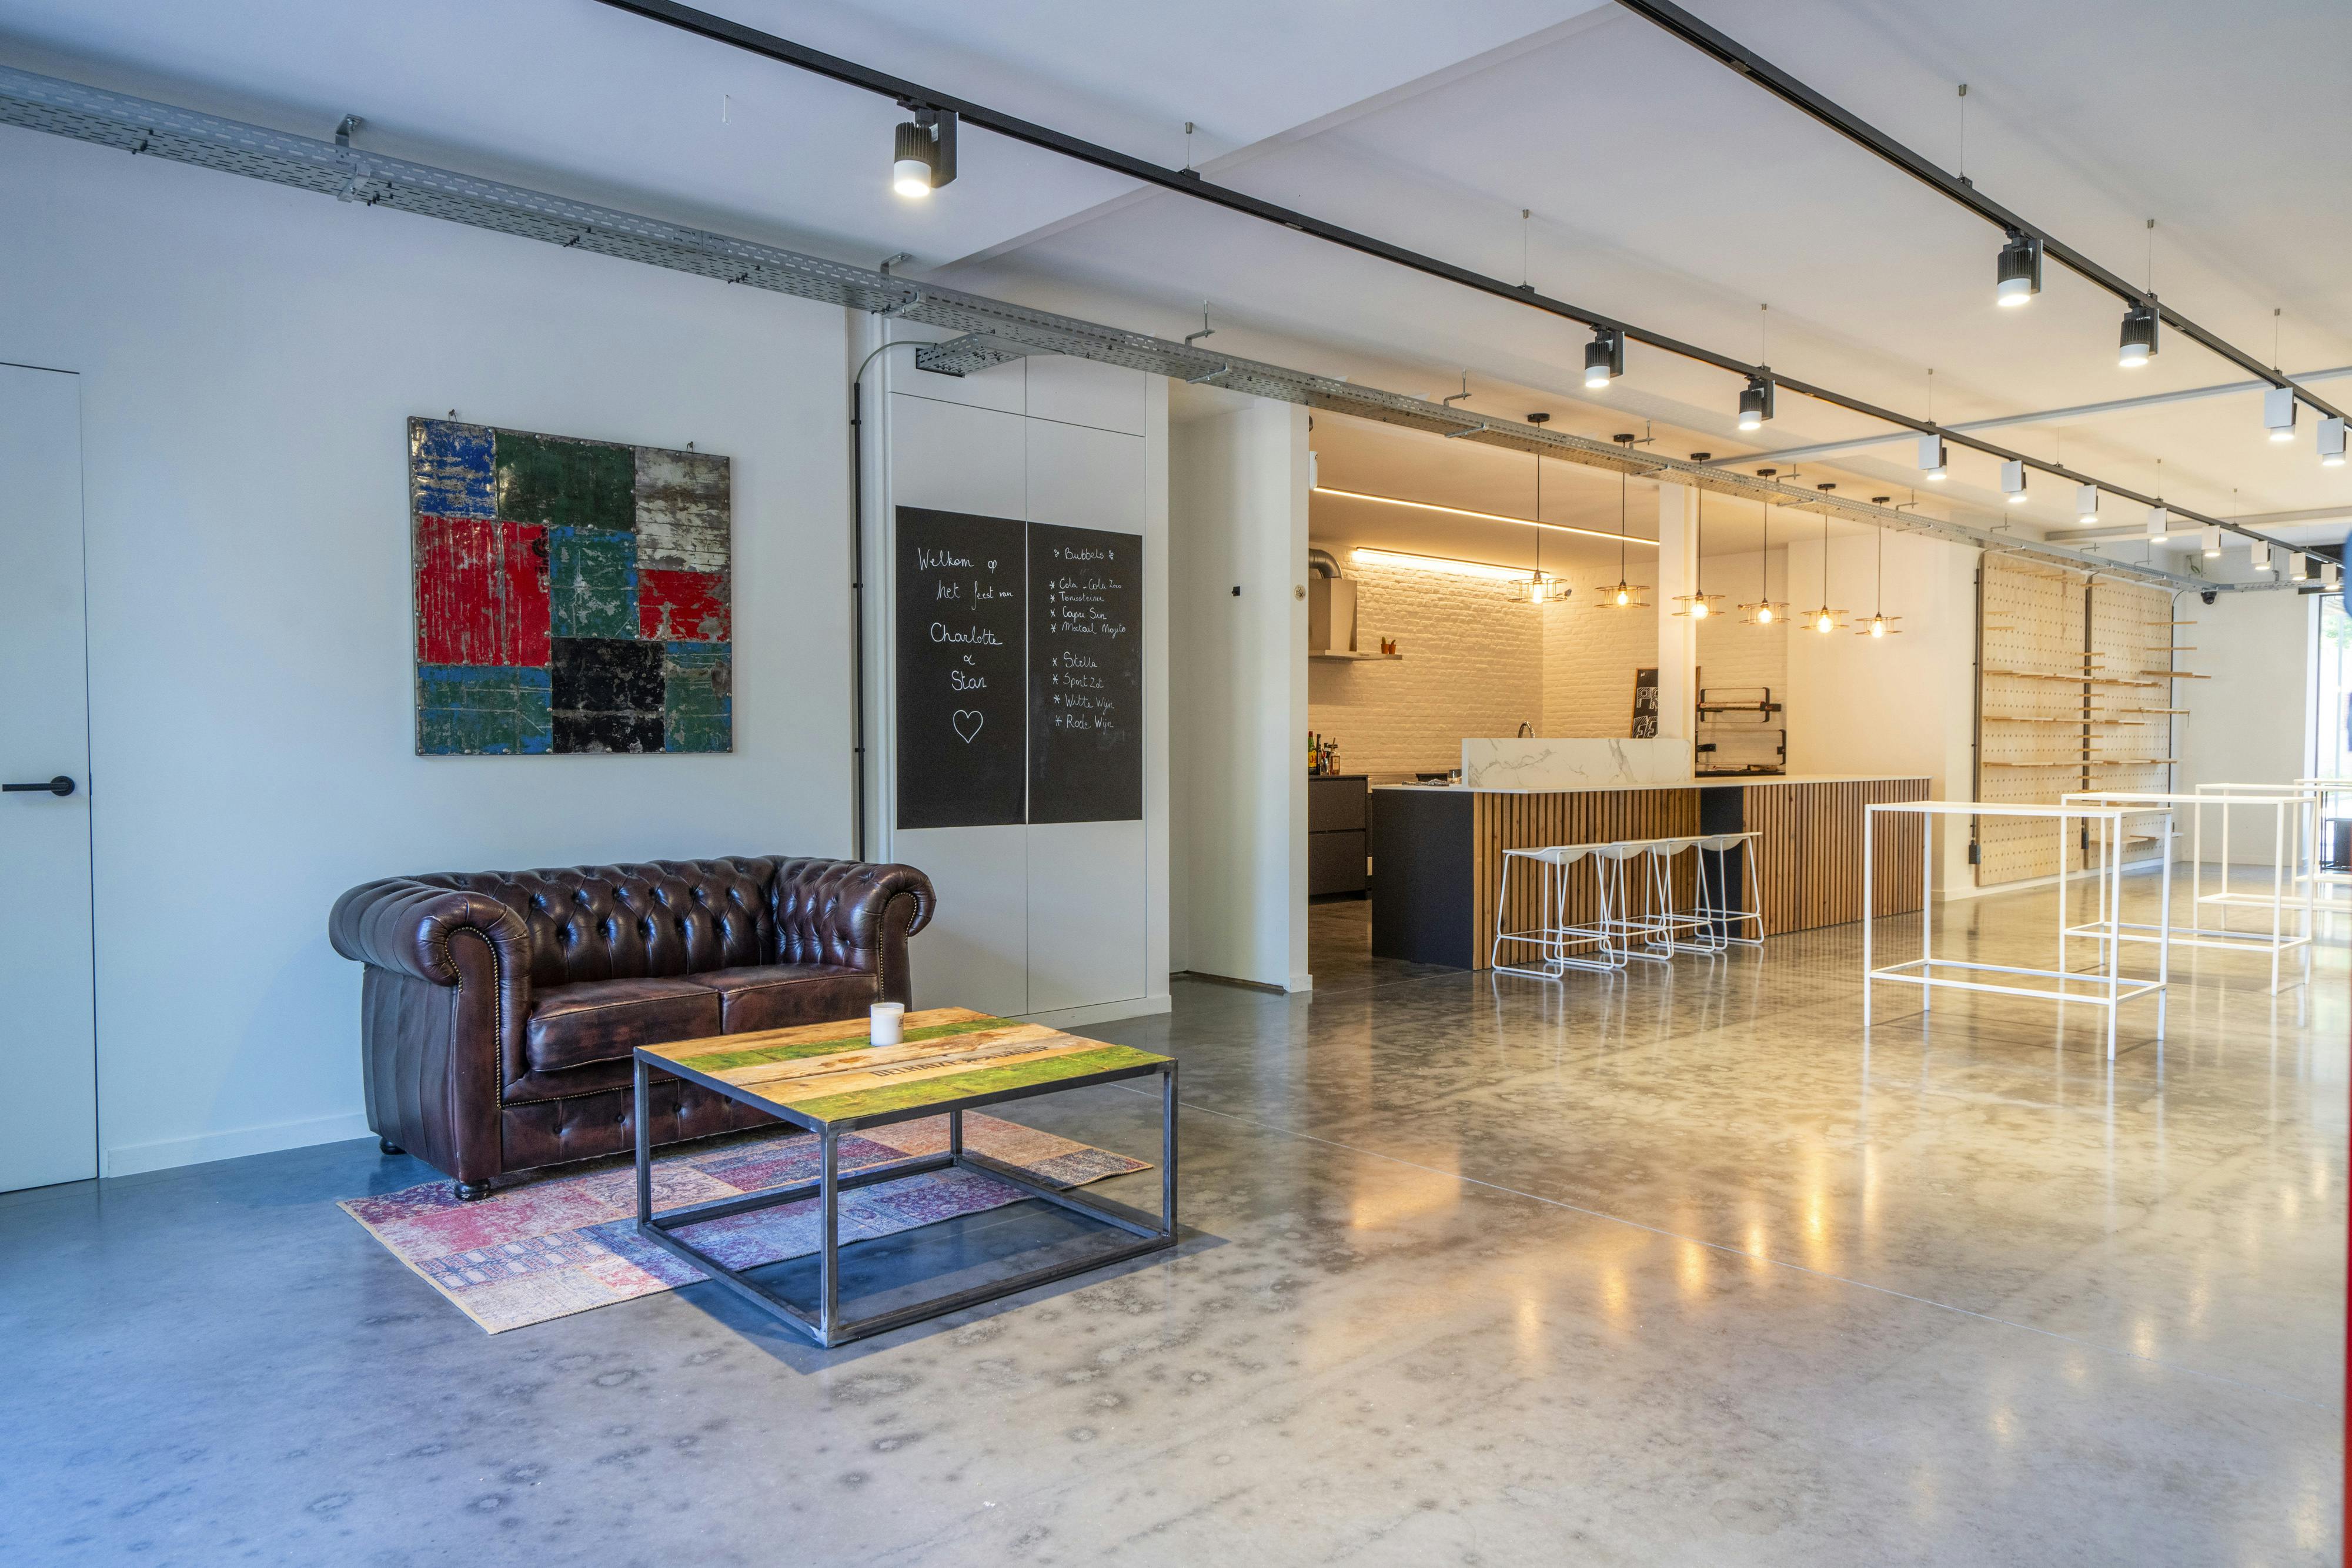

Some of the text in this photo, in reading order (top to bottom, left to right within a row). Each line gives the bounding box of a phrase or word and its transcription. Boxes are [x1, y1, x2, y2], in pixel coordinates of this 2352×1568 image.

[918, 547, 997, 574] Welkom op
[1065, 547, 1104, 560] Bubbels
[1059, 576, 1078, 589] Cola
[1088, 578, 1107, 590] Cola
[1109, 579, 1122, 589] Zero
[936, 580, 961, 601] het
[971, 581, 994, 610] feest
[1063, 606, 1085, 623] Capri
[931, 622, 1003, 645] Charlotte
[1102, 623, 1126, 639] Mojito
[1063, 651, 1098, 668] Stella
[951, 670, 987, 691] Stan
[1063, 672, 1104, 688] Sport Zot
[1065, 693, 1094, 708] Witte
[1067, 713, 1091, 730] Rode
[869, 1059, 961, 1076] DELHAIZE
